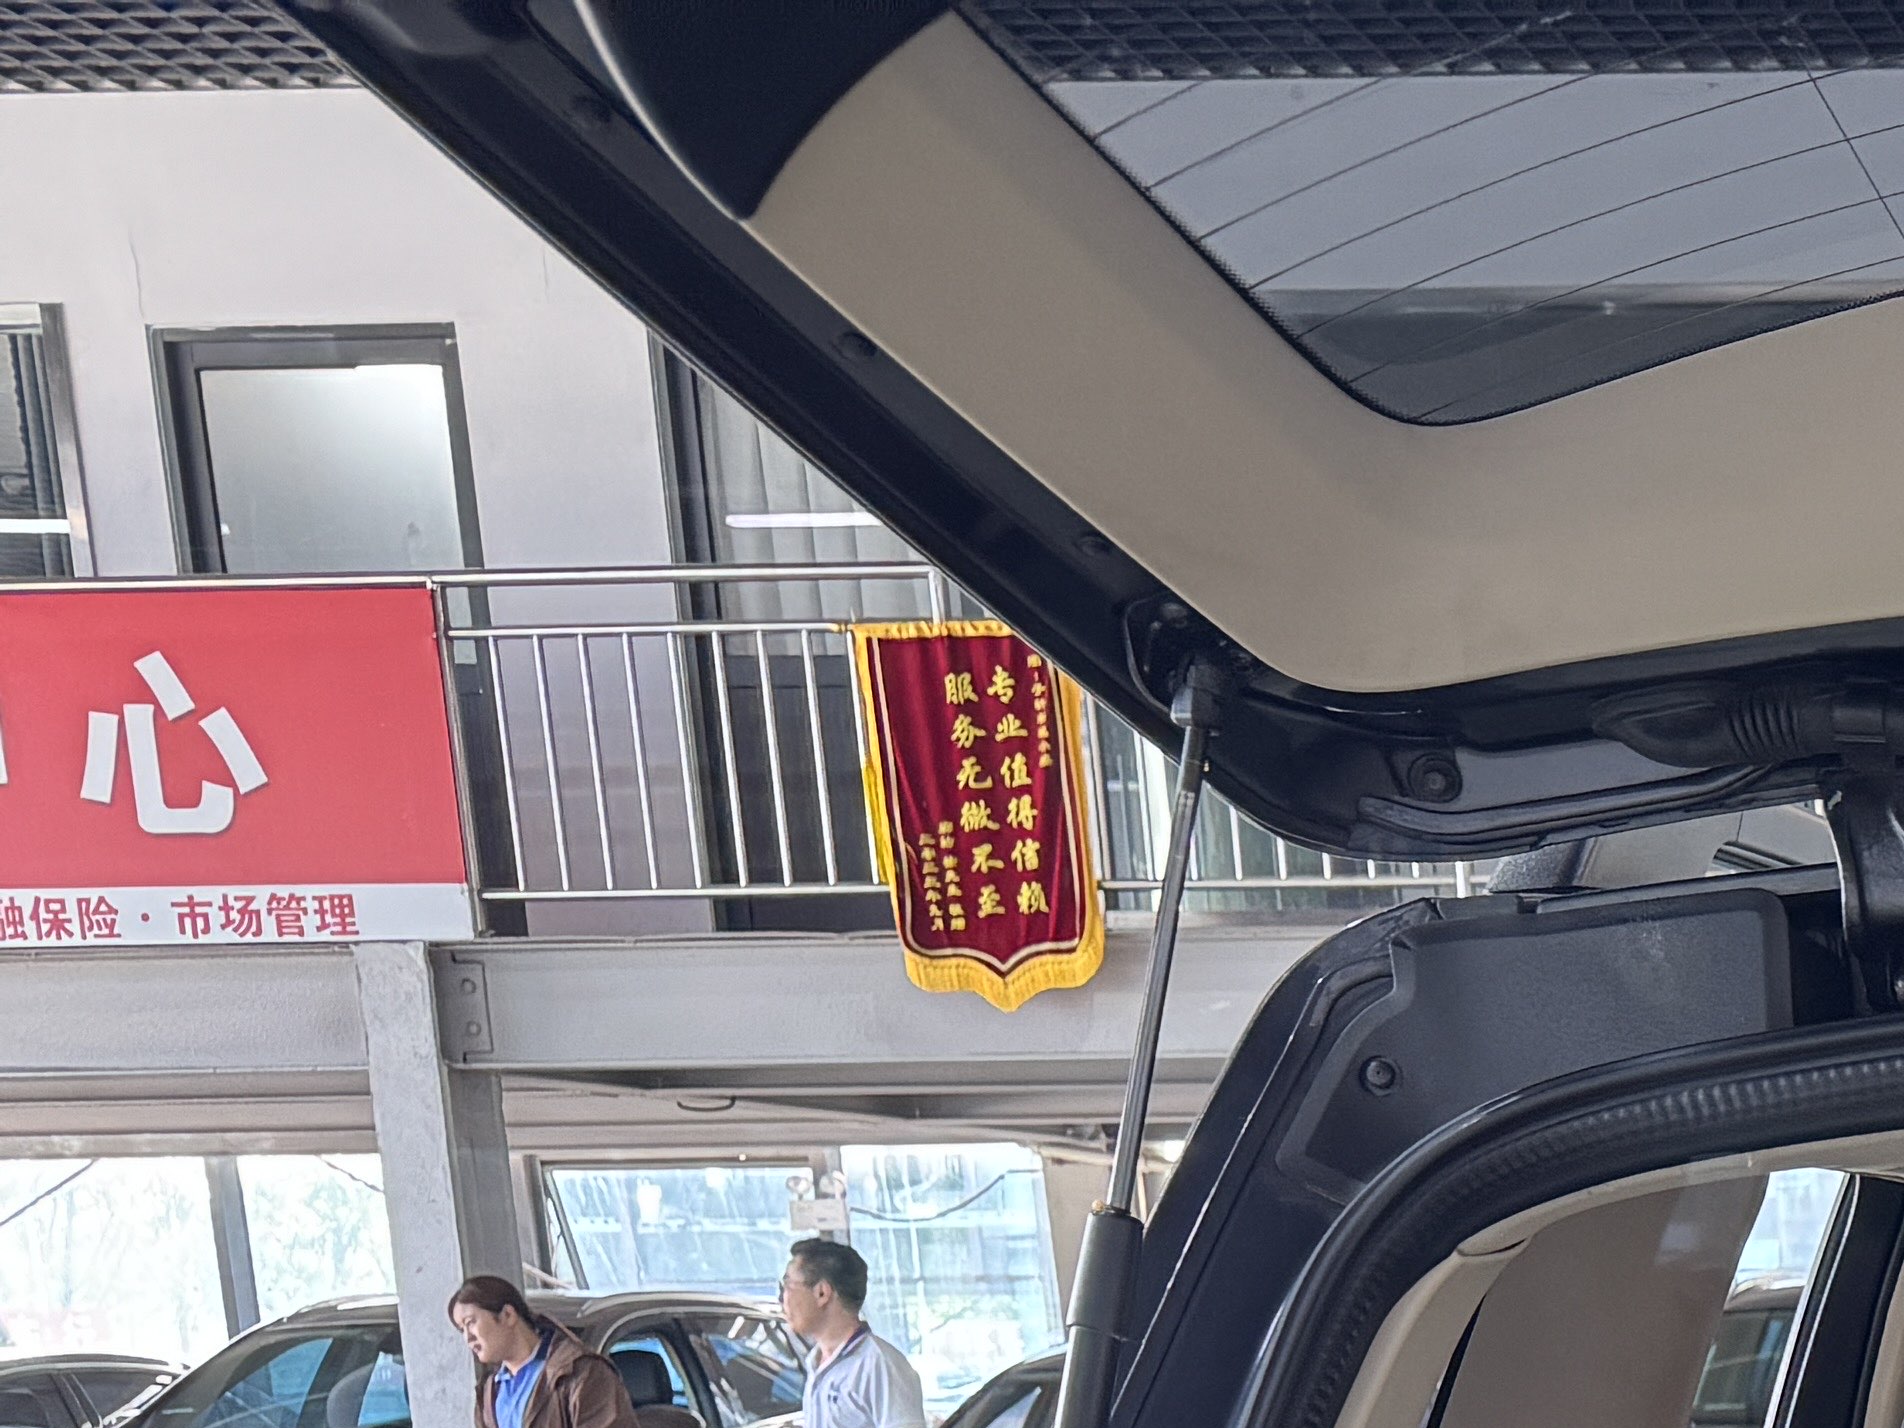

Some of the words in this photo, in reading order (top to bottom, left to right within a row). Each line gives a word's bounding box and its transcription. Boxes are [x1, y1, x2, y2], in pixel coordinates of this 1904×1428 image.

[0, 651, 268, 834] 心
[944, 672, 1006, 919] 服务无微不至
[987, 665, 1050, 915] 专业值得信赖
